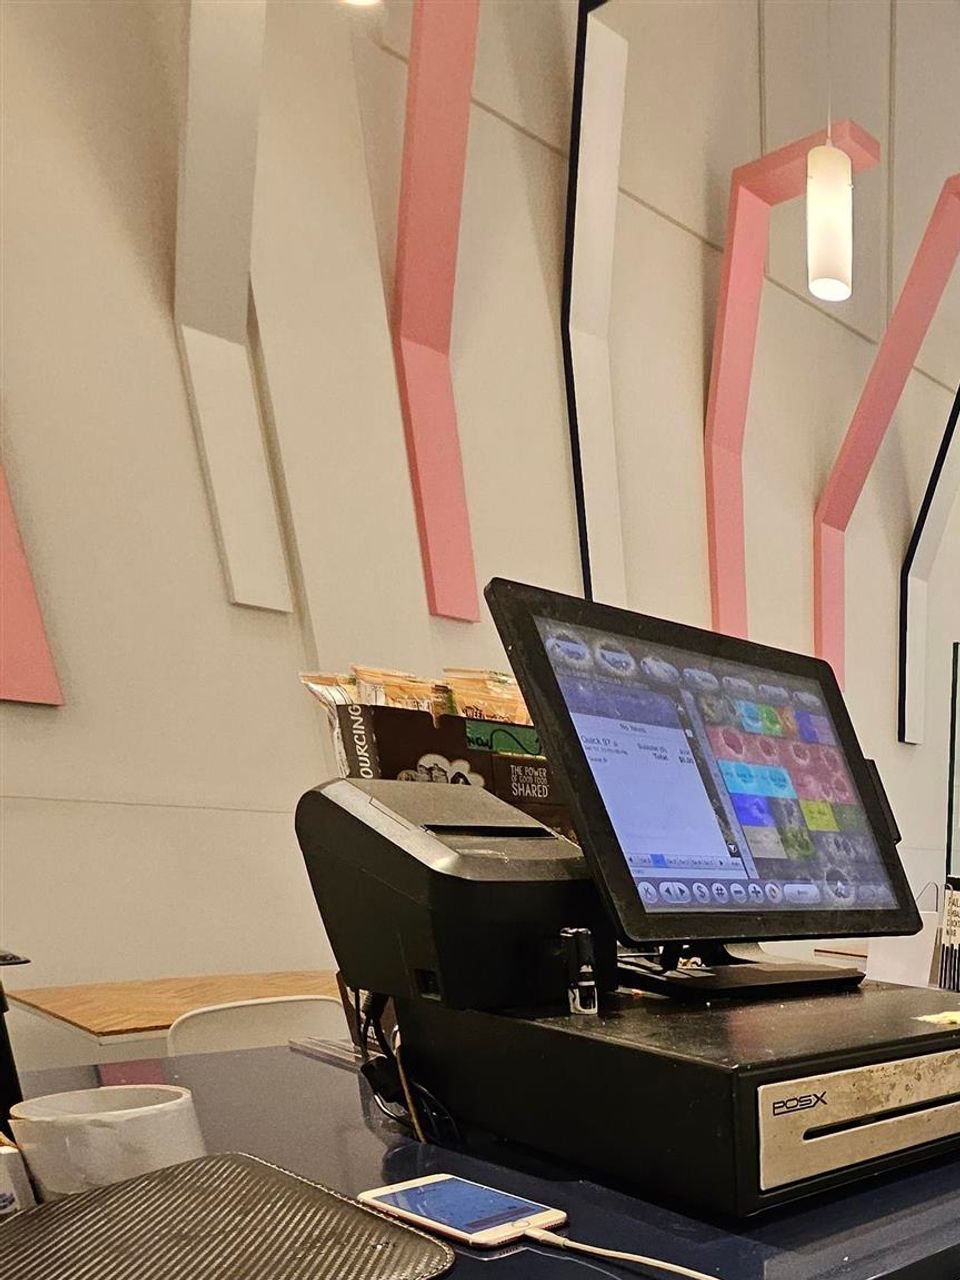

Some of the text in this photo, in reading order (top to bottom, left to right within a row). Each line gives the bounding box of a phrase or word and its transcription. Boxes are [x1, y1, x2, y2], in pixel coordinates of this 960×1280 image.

[348, 704, 373, 779] OURCING
[510, 764, 547, 777] THE POWER
[511, 782, 548, 798] SHARED
[772, 1091, 828, 1116] POSX
